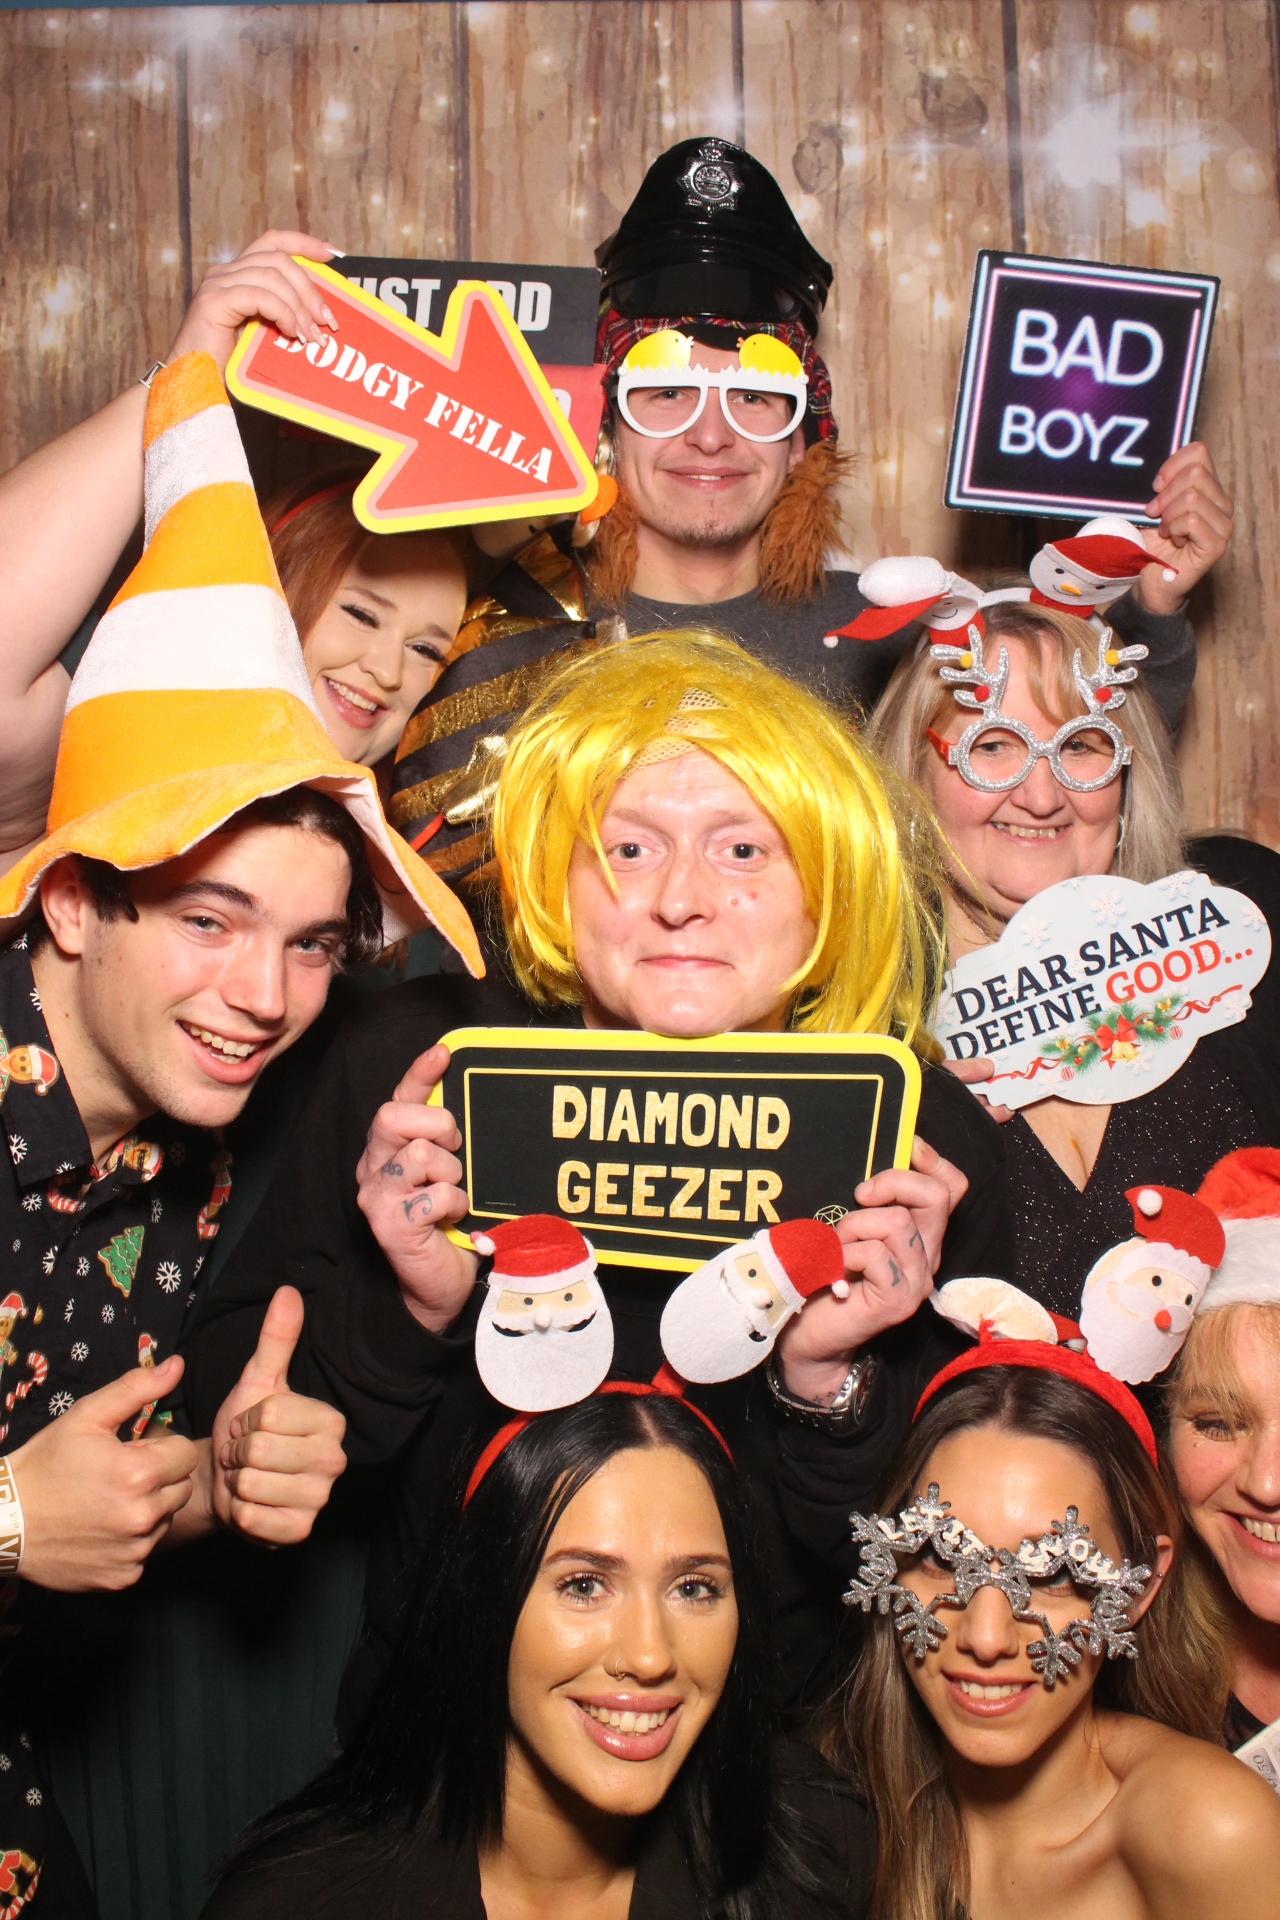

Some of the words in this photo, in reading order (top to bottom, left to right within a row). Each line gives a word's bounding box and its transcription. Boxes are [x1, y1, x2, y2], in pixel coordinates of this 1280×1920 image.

[1010, 309, 1164, 386] BAD
[424, 392, 553, 484] FELLA
[1000, 405, 1149, 466] BOYZ
[946, 984, 1103, 1060] DEFINE
[1105, 939, 1253, 1004] GOOD...
[953, 954, 1076, 1024] DEAR
[1079, 898, 1229, 976] SANTA
[552, 1085, 790, 1151] DIAMOND
[557, 1161, 783, 1223] GEEZER
